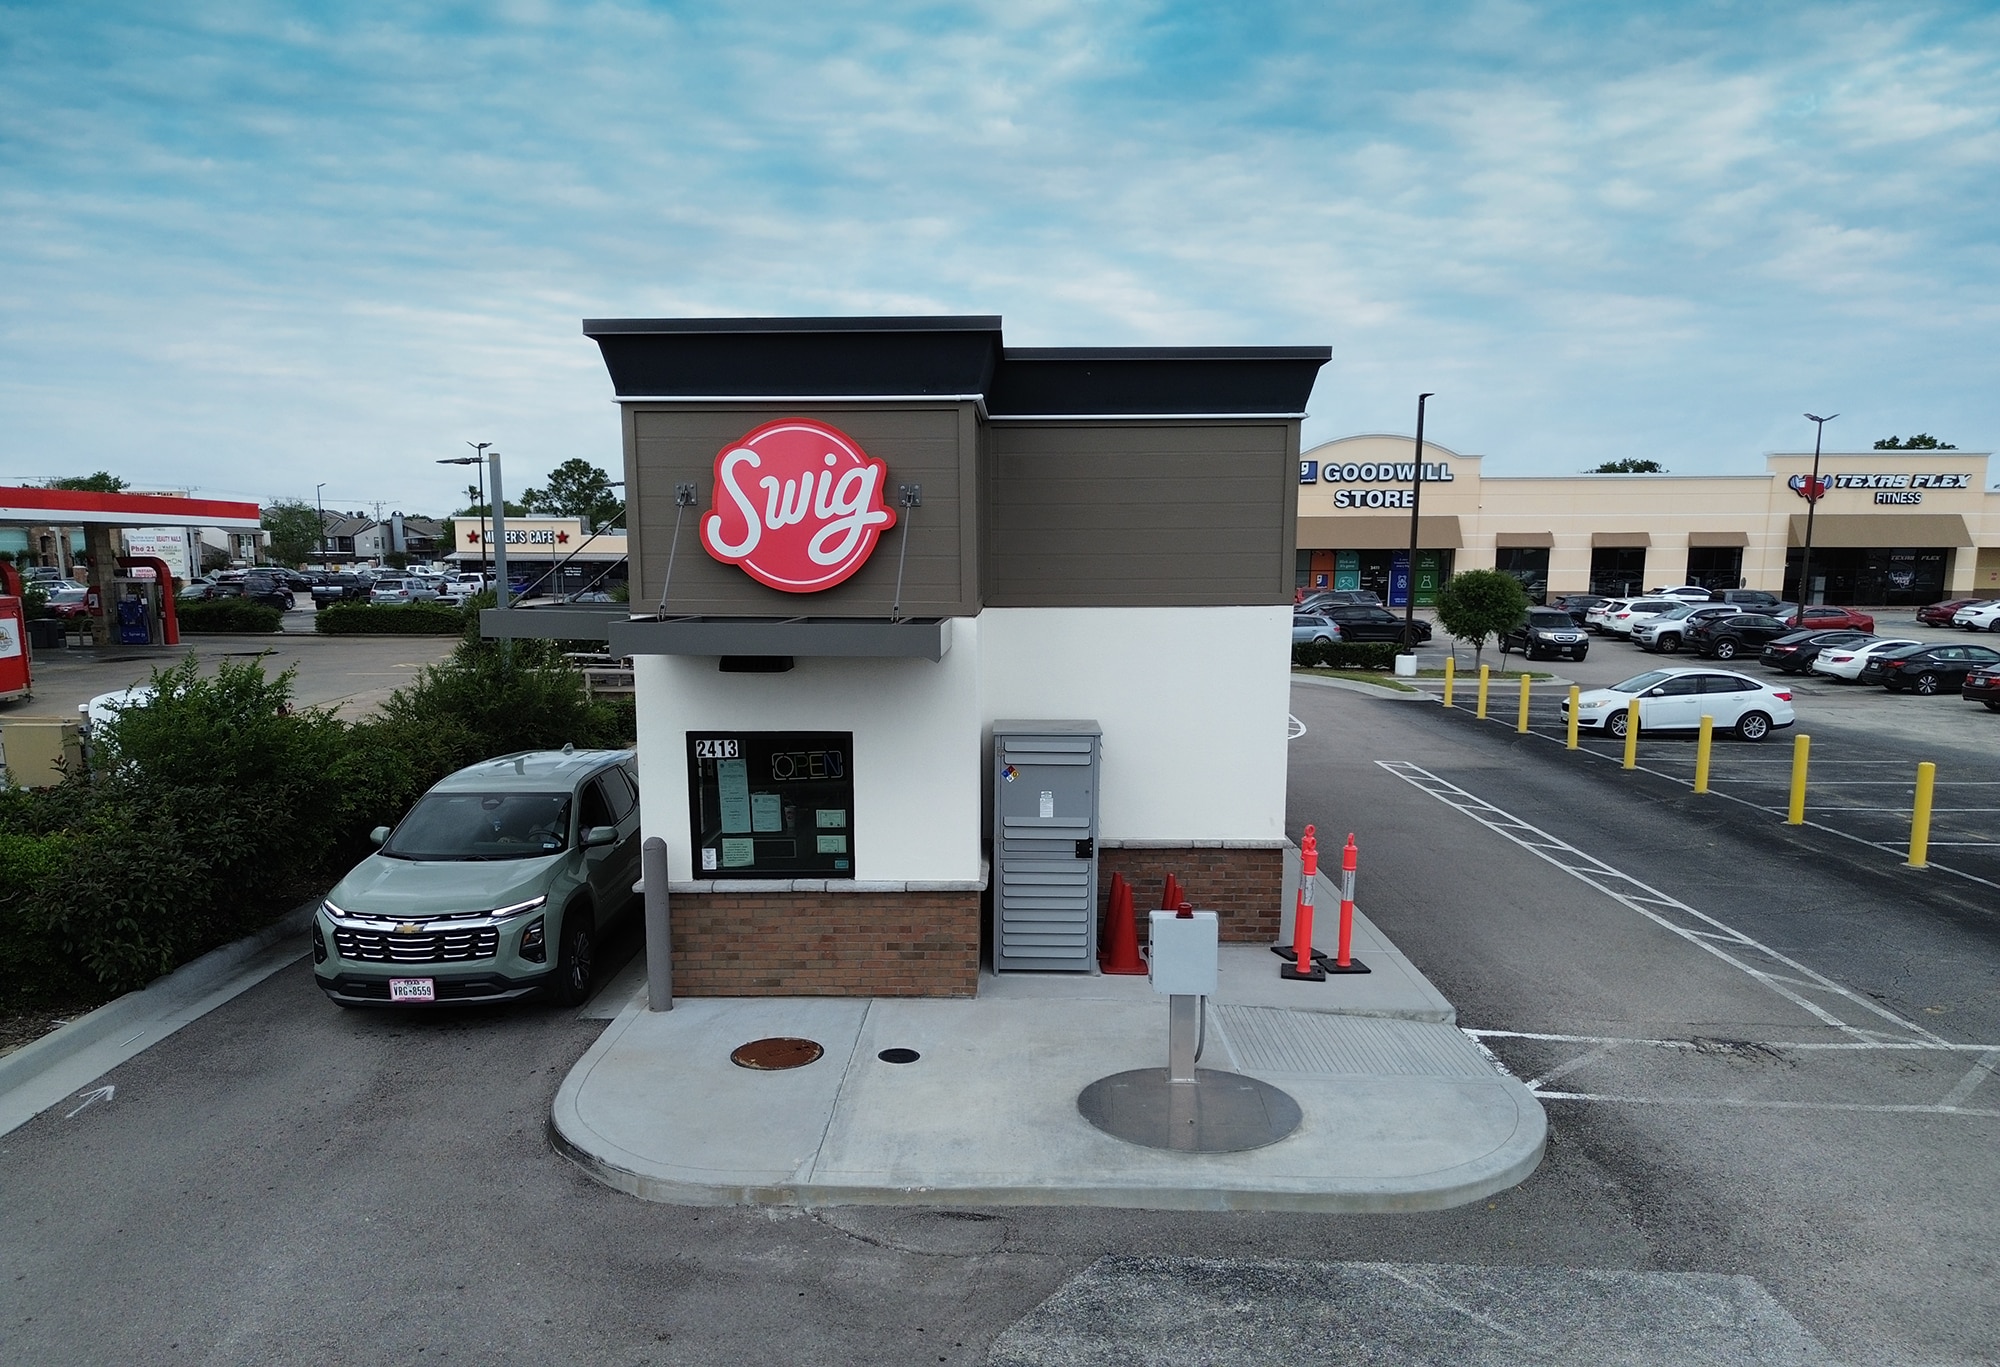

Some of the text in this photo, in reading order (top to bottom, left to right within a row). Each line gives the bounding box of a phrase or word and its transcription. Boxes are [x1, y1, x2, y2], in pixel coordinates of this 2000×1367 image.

[1324, 464, 1453, 482] GOODWILL
[1837, 474, 1972, 488] TEXAS FLEX
[1334, 490, 1414, 507] STORE
[1875, 492, 1922, 504] FITNESS
[707, 448, 888, 566] Swig
[484, 531, 554, 543] MIER'S CAFE
[697, 741, 737, 757] 2413
[774, 753, 841, 777] OPEN
